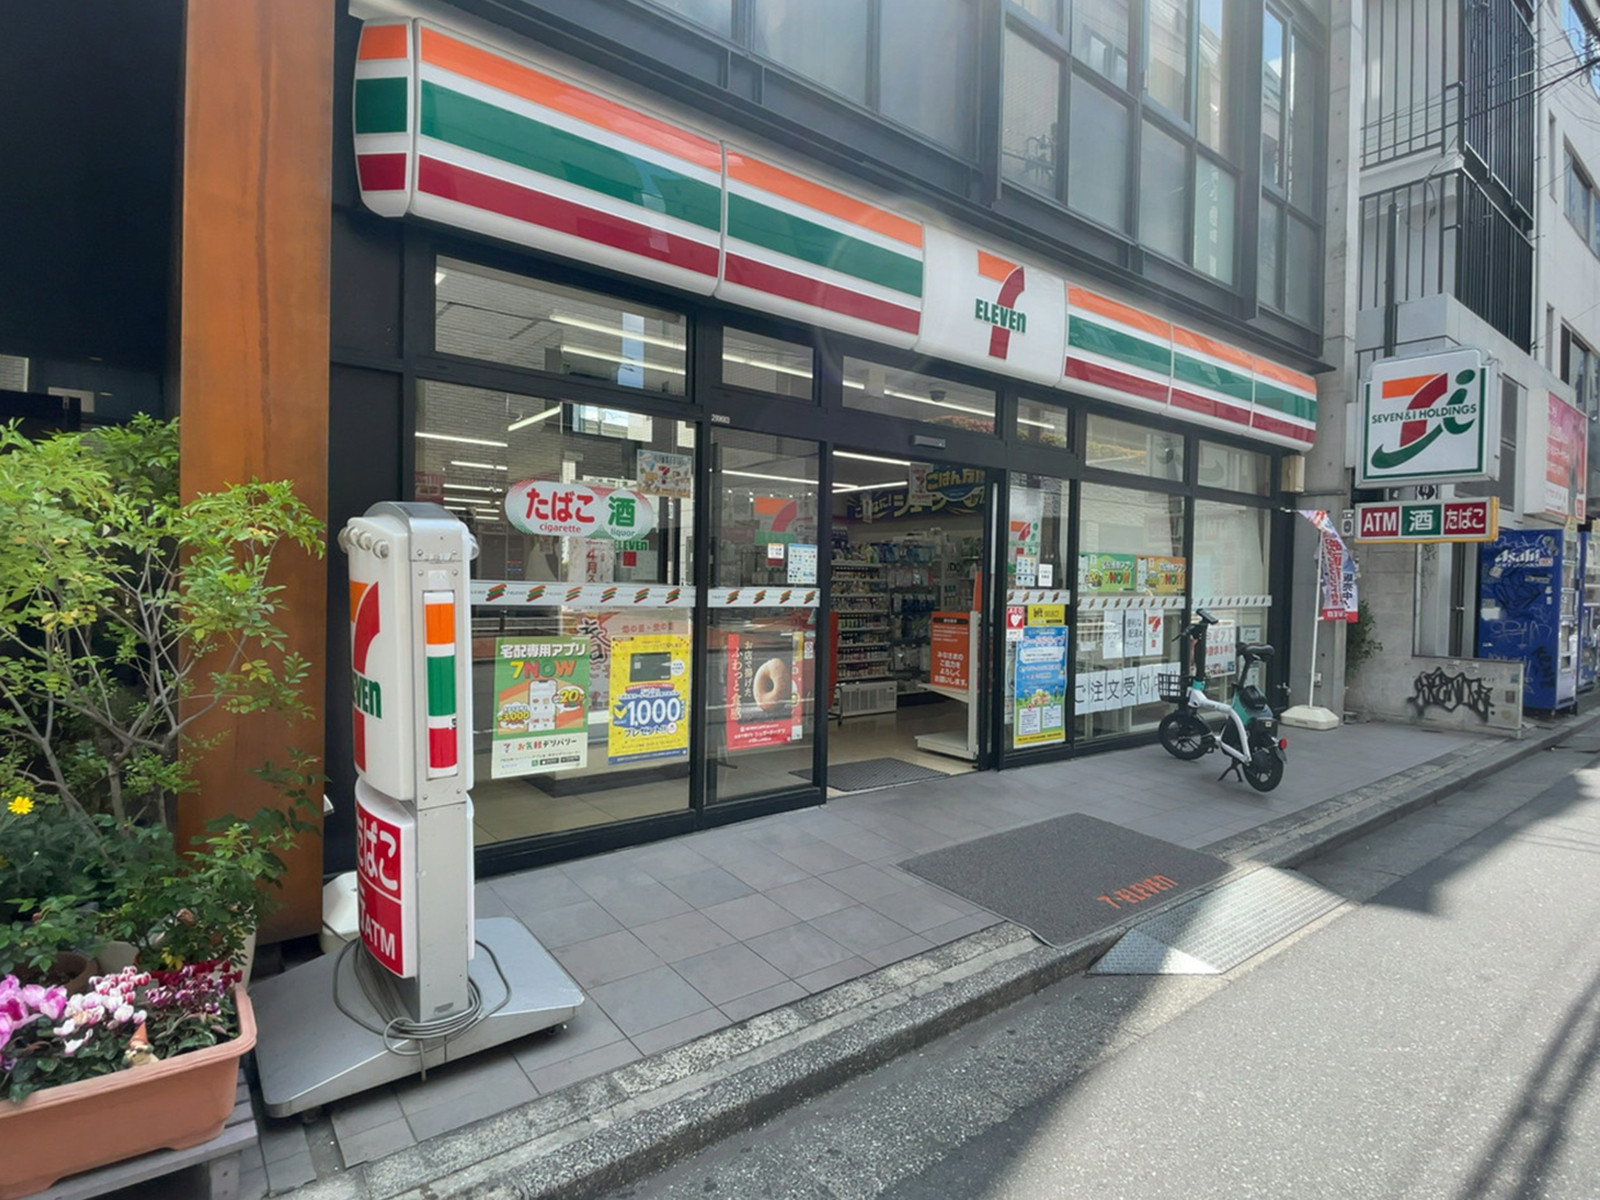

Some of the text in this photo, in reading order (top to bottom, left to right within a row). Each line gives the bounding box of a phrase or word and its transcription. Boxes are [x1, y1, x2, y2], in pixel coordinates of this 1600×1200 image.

[1418, 403, 1477, 420] HOLDINGS
[526, 487, 595, 523] たばこ
[608, 495, 636, 527] 酒
[1363, 512, 1397, 532] ATM
[1409, 509, 1434, 532] 酒
[1446, 507, 1485, 530] たばこ
[539, 523, 582, 534] cigarette
[610, 529, 636, 539] liquor
[1495, 549, 1541, 562] Asahi
[500, 643, 586, 659] 宅配専用アプリ
[510, 660, 577, 679] 7NOW
[627, 698, 681, 727] 1,000
